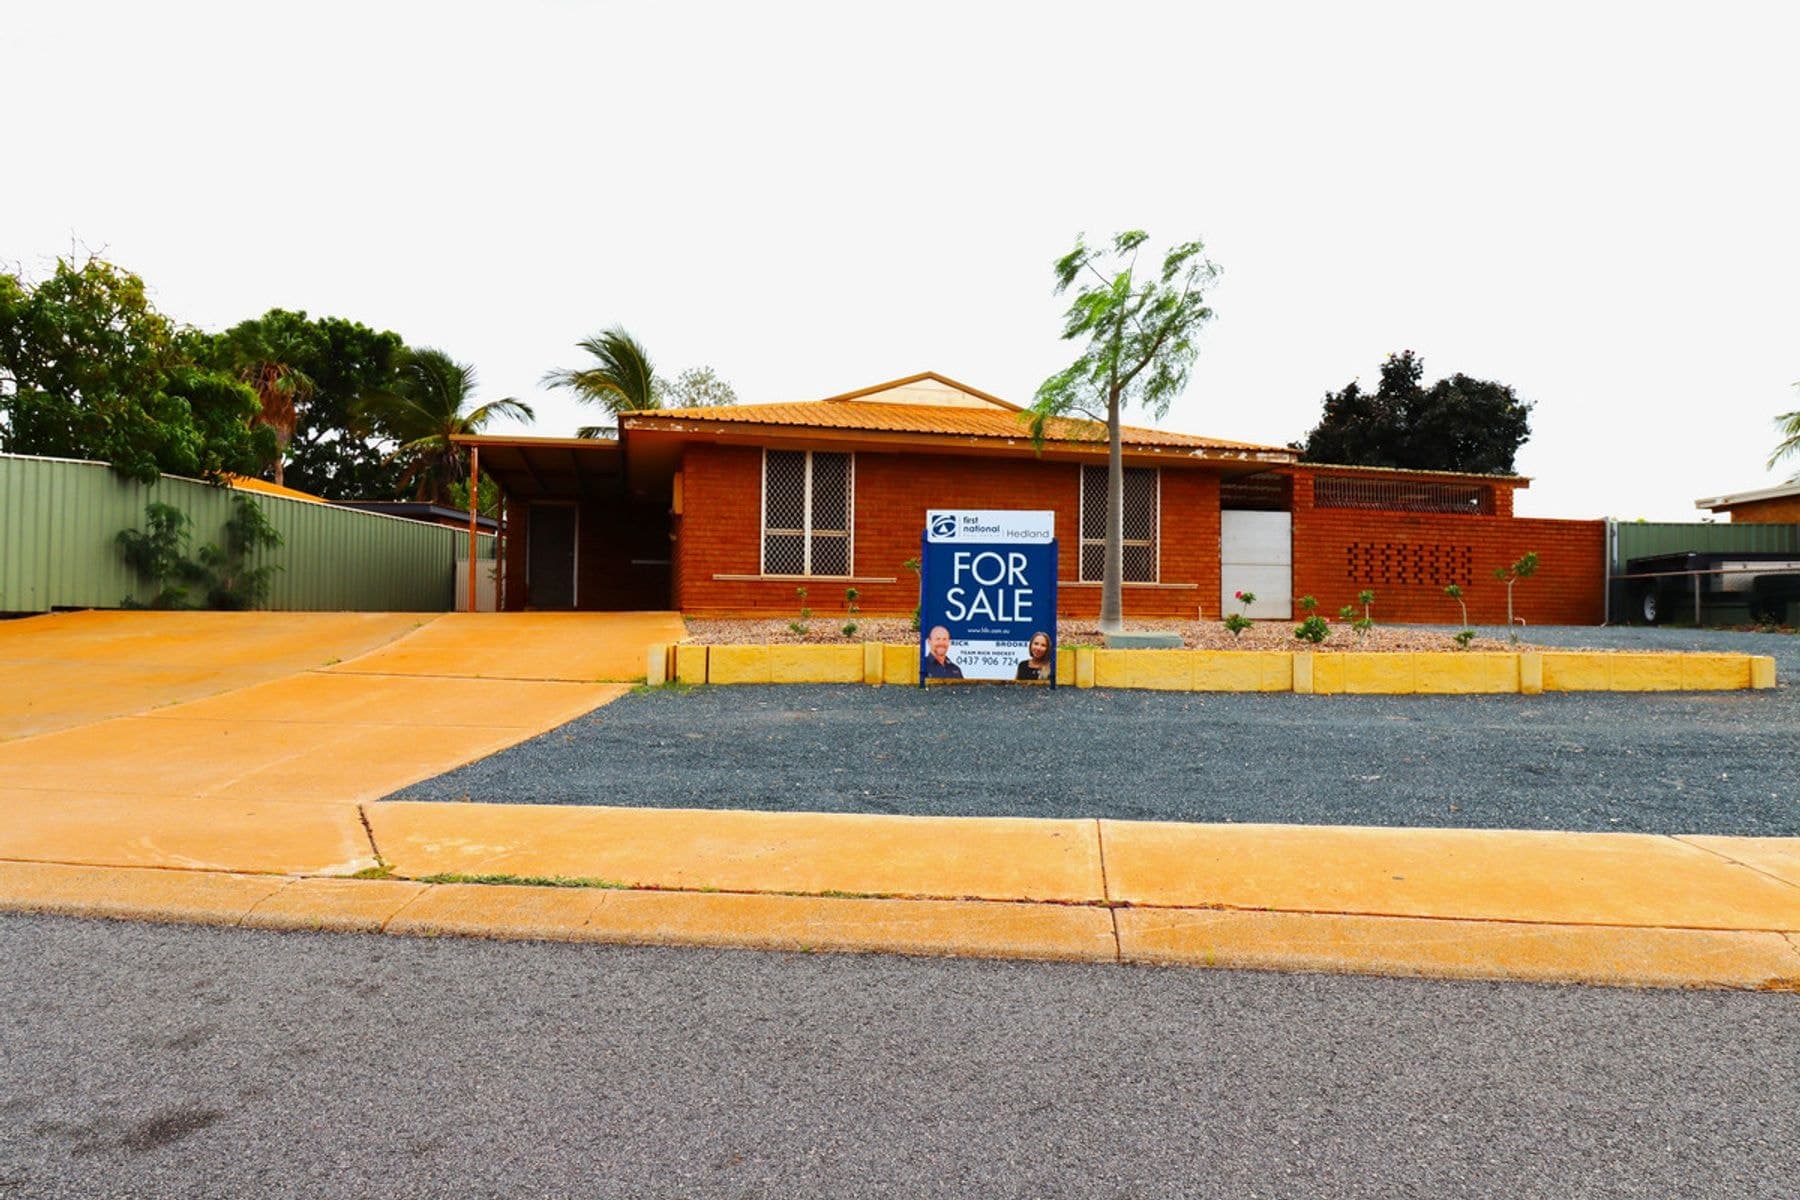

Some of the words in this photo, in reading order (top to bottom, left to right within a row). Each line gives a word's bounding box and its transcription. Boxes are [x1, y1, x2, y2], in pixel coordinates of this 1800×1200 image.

[963, 516, 979, 524] first
[1006, 529, 1049, 538] Hedland
[954, 551, 1029, 586] FOR
[945, 587, 1033, 622] SALE
[956, 656, 979, 666] 0437
[981, 656, 999, 666] 906
[1002, 656, 1019, 666] 724
